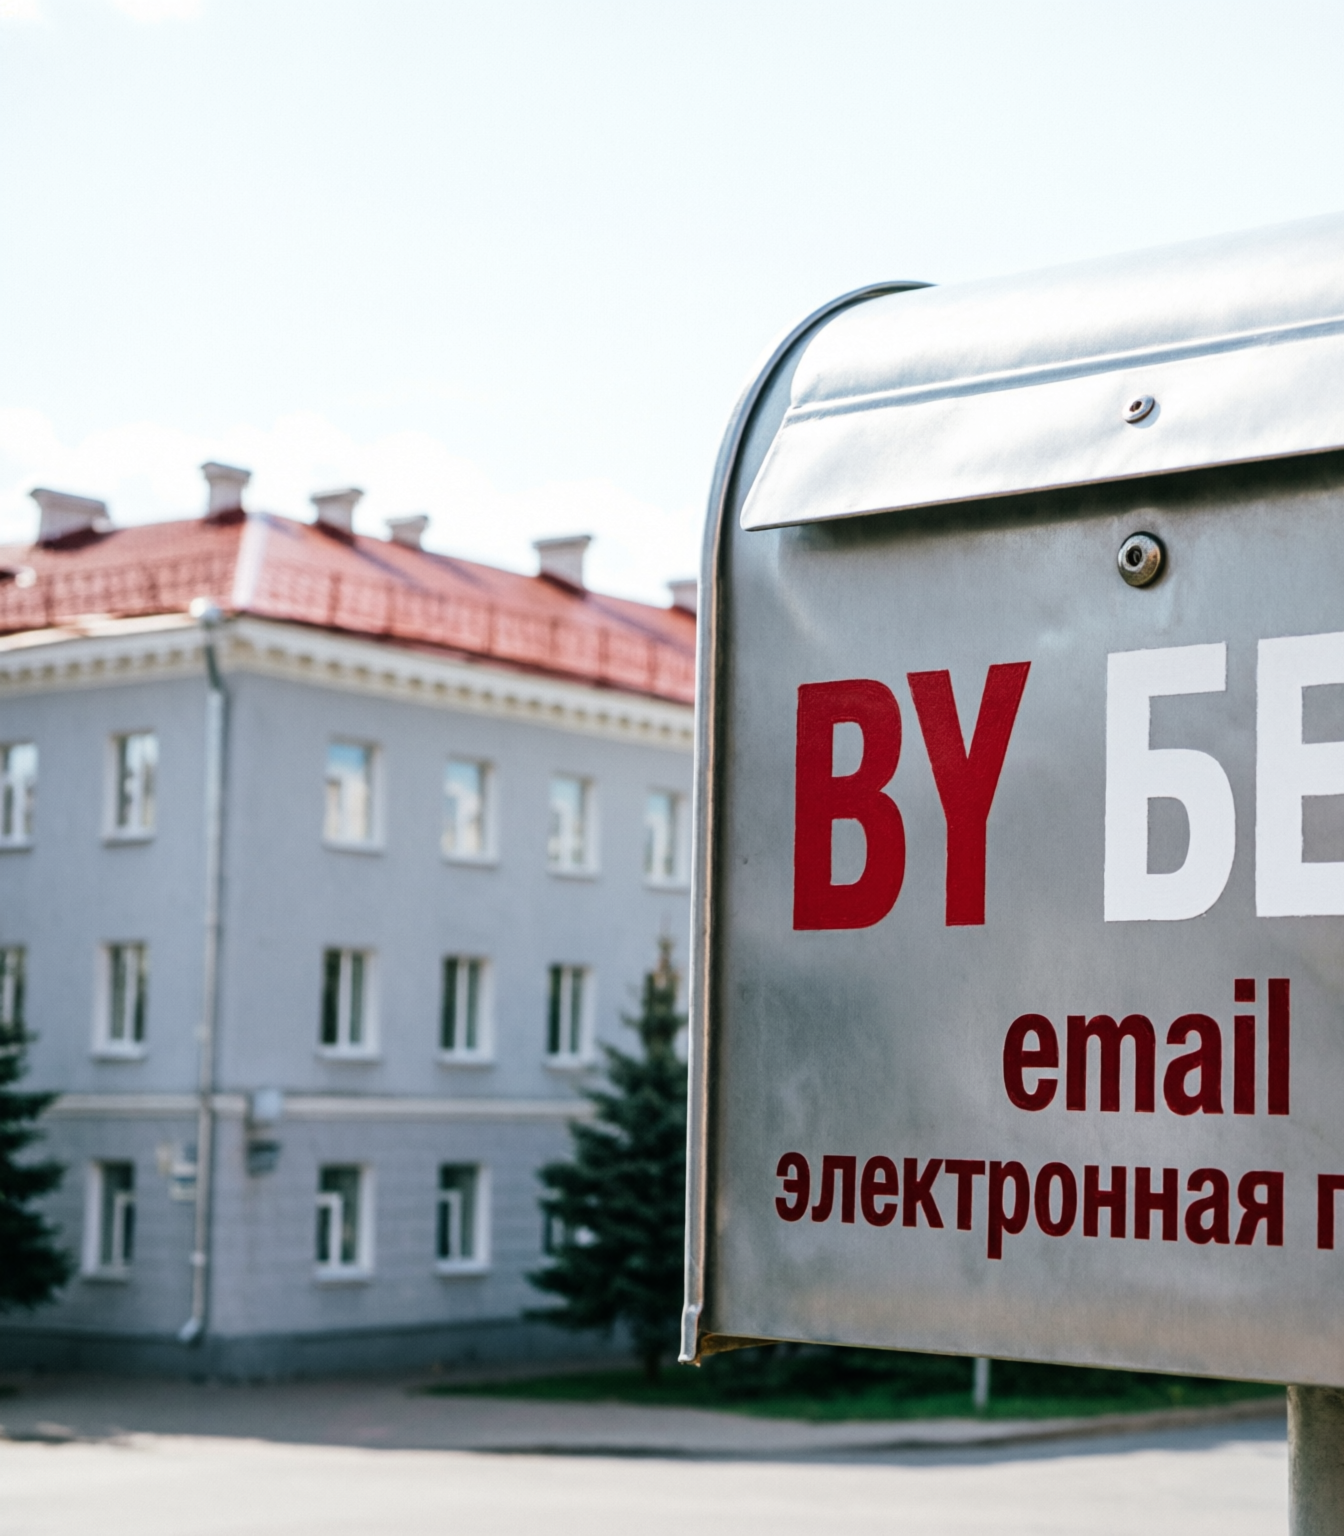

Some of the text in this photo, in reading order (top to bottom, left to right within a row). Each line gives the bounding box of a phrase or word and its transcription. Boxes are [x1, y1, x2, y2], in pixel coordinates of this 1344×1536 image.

[792, 661, 1032, 931] BY
[1003, 978, 1291, 1116] email
[775, 1151, 1284, 1260] электронная
